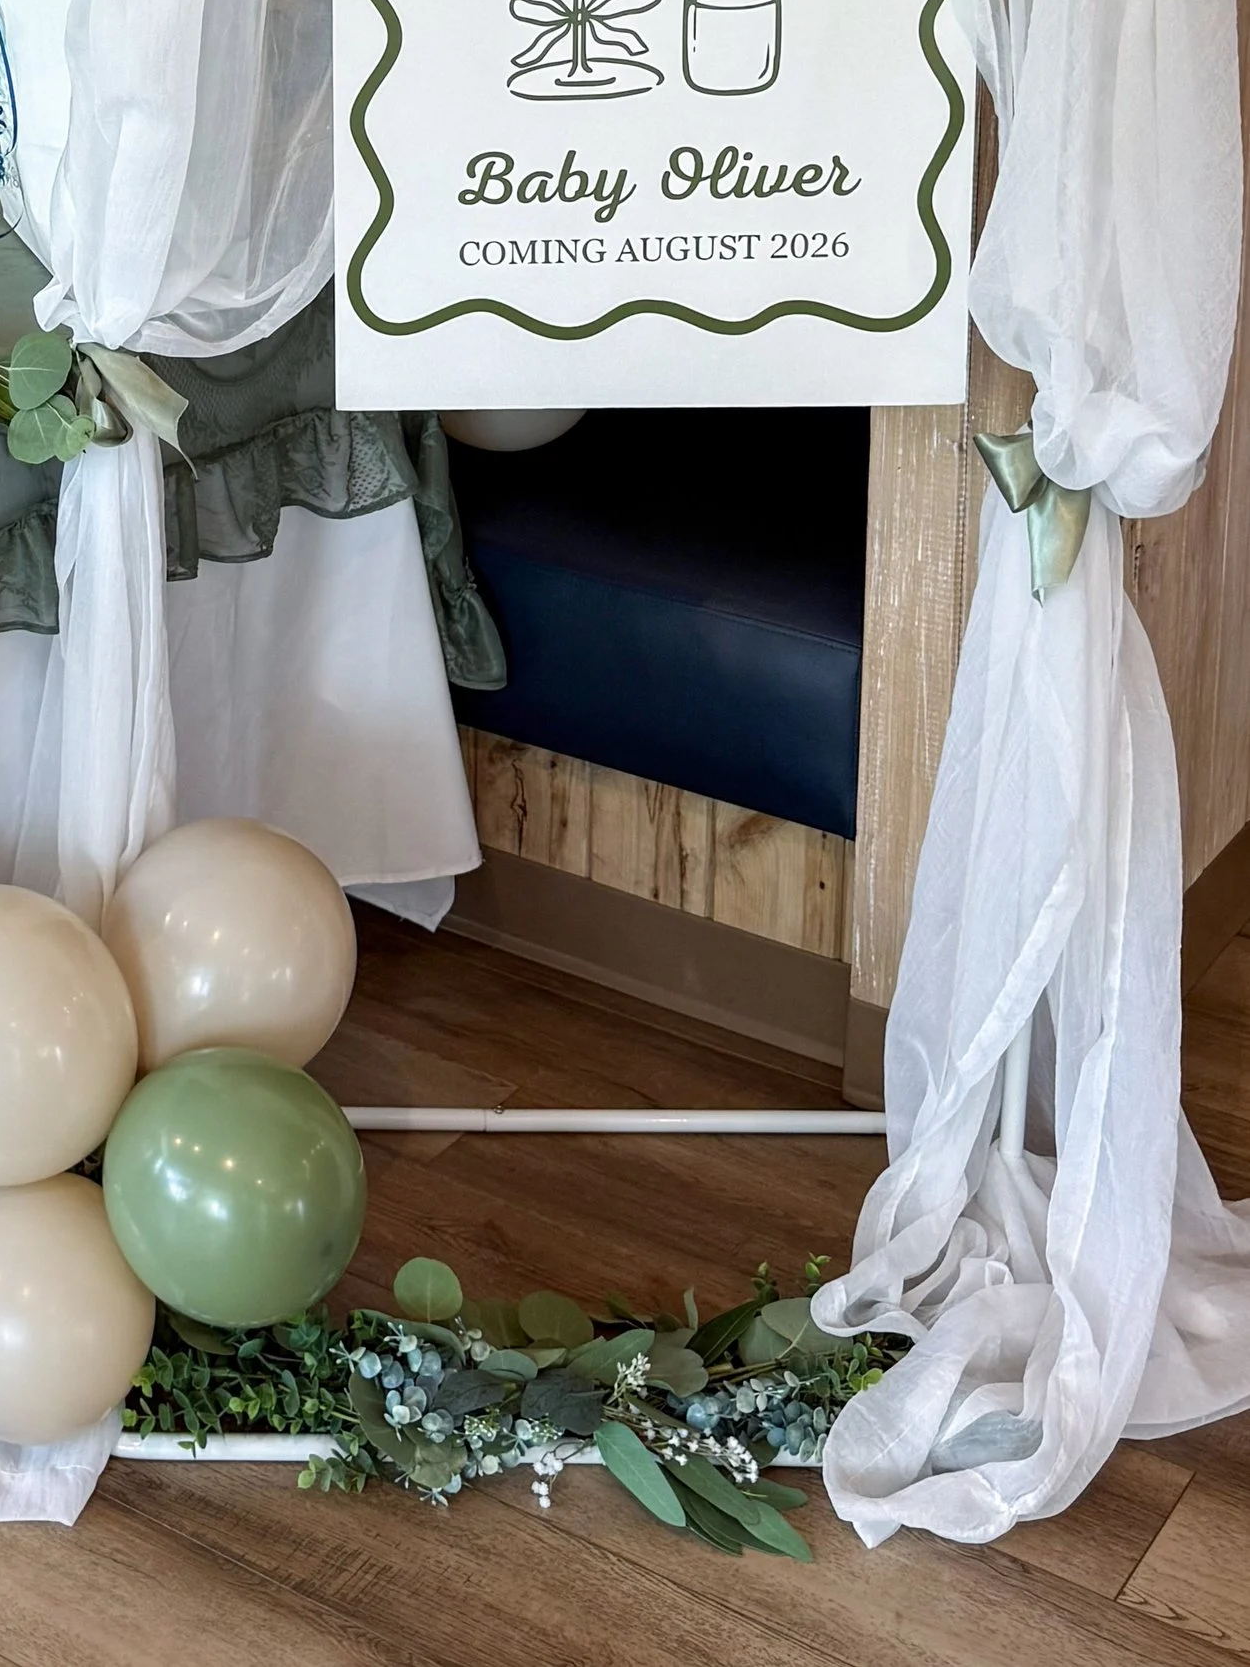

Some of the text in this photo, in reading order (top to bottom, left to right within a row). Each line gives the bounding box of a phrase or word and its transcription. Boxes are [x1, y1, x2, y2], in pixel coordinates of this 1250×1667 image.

[457, 145, 862, 224] Baby Oliver
[459, 231, 850, 267] COMING AUGUST 2026
